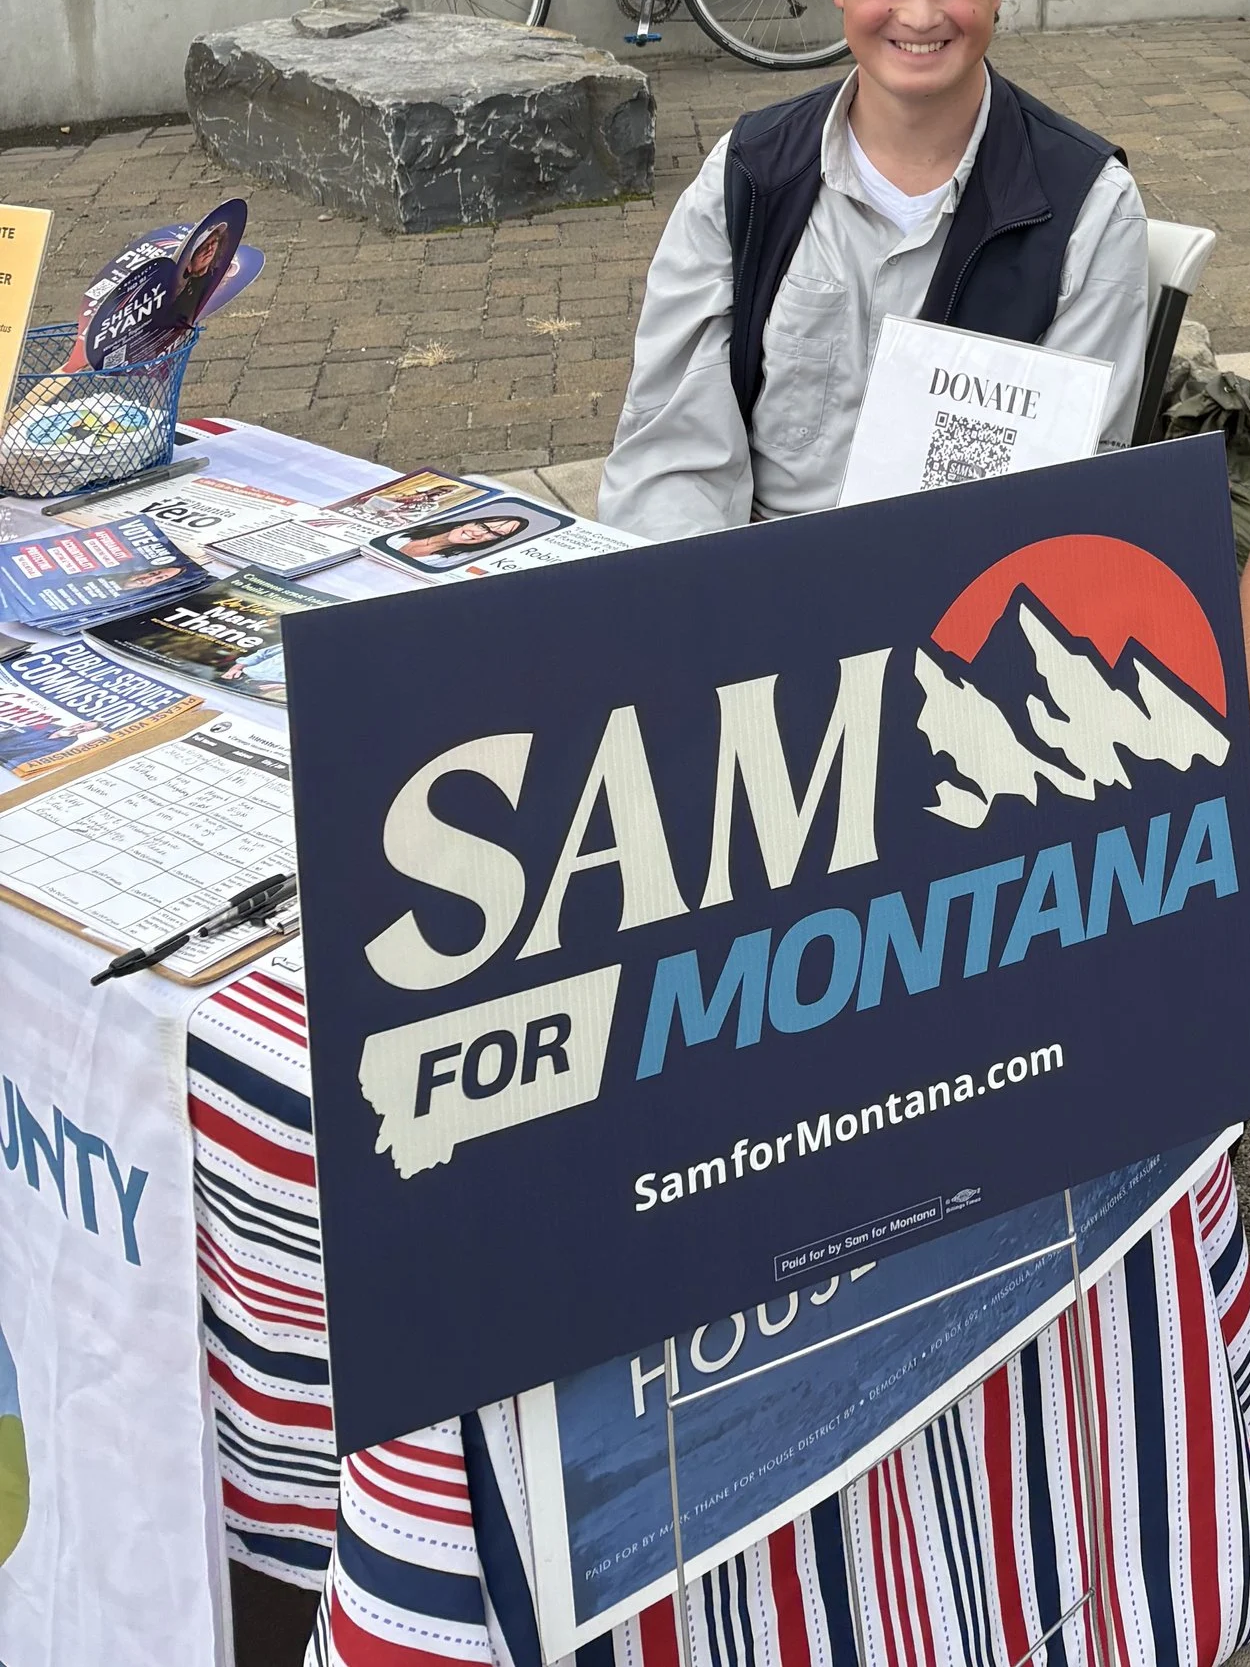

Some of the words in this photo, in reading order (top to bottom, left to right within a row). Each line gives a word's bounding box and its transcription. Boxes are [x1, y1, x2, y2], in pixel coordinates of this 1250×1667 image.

[93, 289, 167, 350] FYANT
[100, 283, 162, 332] SHELLY
[928, 367, 1041, 420] DONATE
[118, 518, 159, 547] VOTE
[139, 501, 223, 528] Vero
[163, 607, 264, 648] Thane
[202, 606, 269, 632] Mark
[10, 653, 152, 730] COMMISSION
[51, 643, 124, 682] PUBLIC
[101, 672, 184, 711] SERVICE
[116, 719, 150, 737] VOTE
[149, 697, 197, 722] PLEASE
[28, 735, 114, 768] RESPONSIBLY
[364, 646, 894, 992] SAM
[635, 795, 1240, 1082] MONTANA
[413, 1012, 572, 1119] FOR
[634, 1043, 1065, 1213] SamforMontana.com
[781, 1254, 806, 1272] Paid
[809, 1247, 825, 1262] for
[828, 1242, 842, 1255] by
[845, 1233, 869, 1249] Sam
[871, 1226, 887, 1239] for
[890, 1207, 936, 1232] Montana
[585, 1559, 611, 1581] PAID
[615, 1542, 638, 1563] FOR
[642, 1533, 656, 1548] BY
[695, 1487, 729, 1515] THANE
[733, 1471, 755, 1492] FOR
[758, 1446, 795, 1477] HOUSE
[798, 1414, 840, 1450] DISTRICT
[844, 1404, 856, 1420] 89
[869, 1357, 918, 1401] DEMOCRAT
[930, 1338, 943, 1354] PO
[945, 1321, 962, 1341] BOX
[1080, 1213, 1098, 1233] GARY
